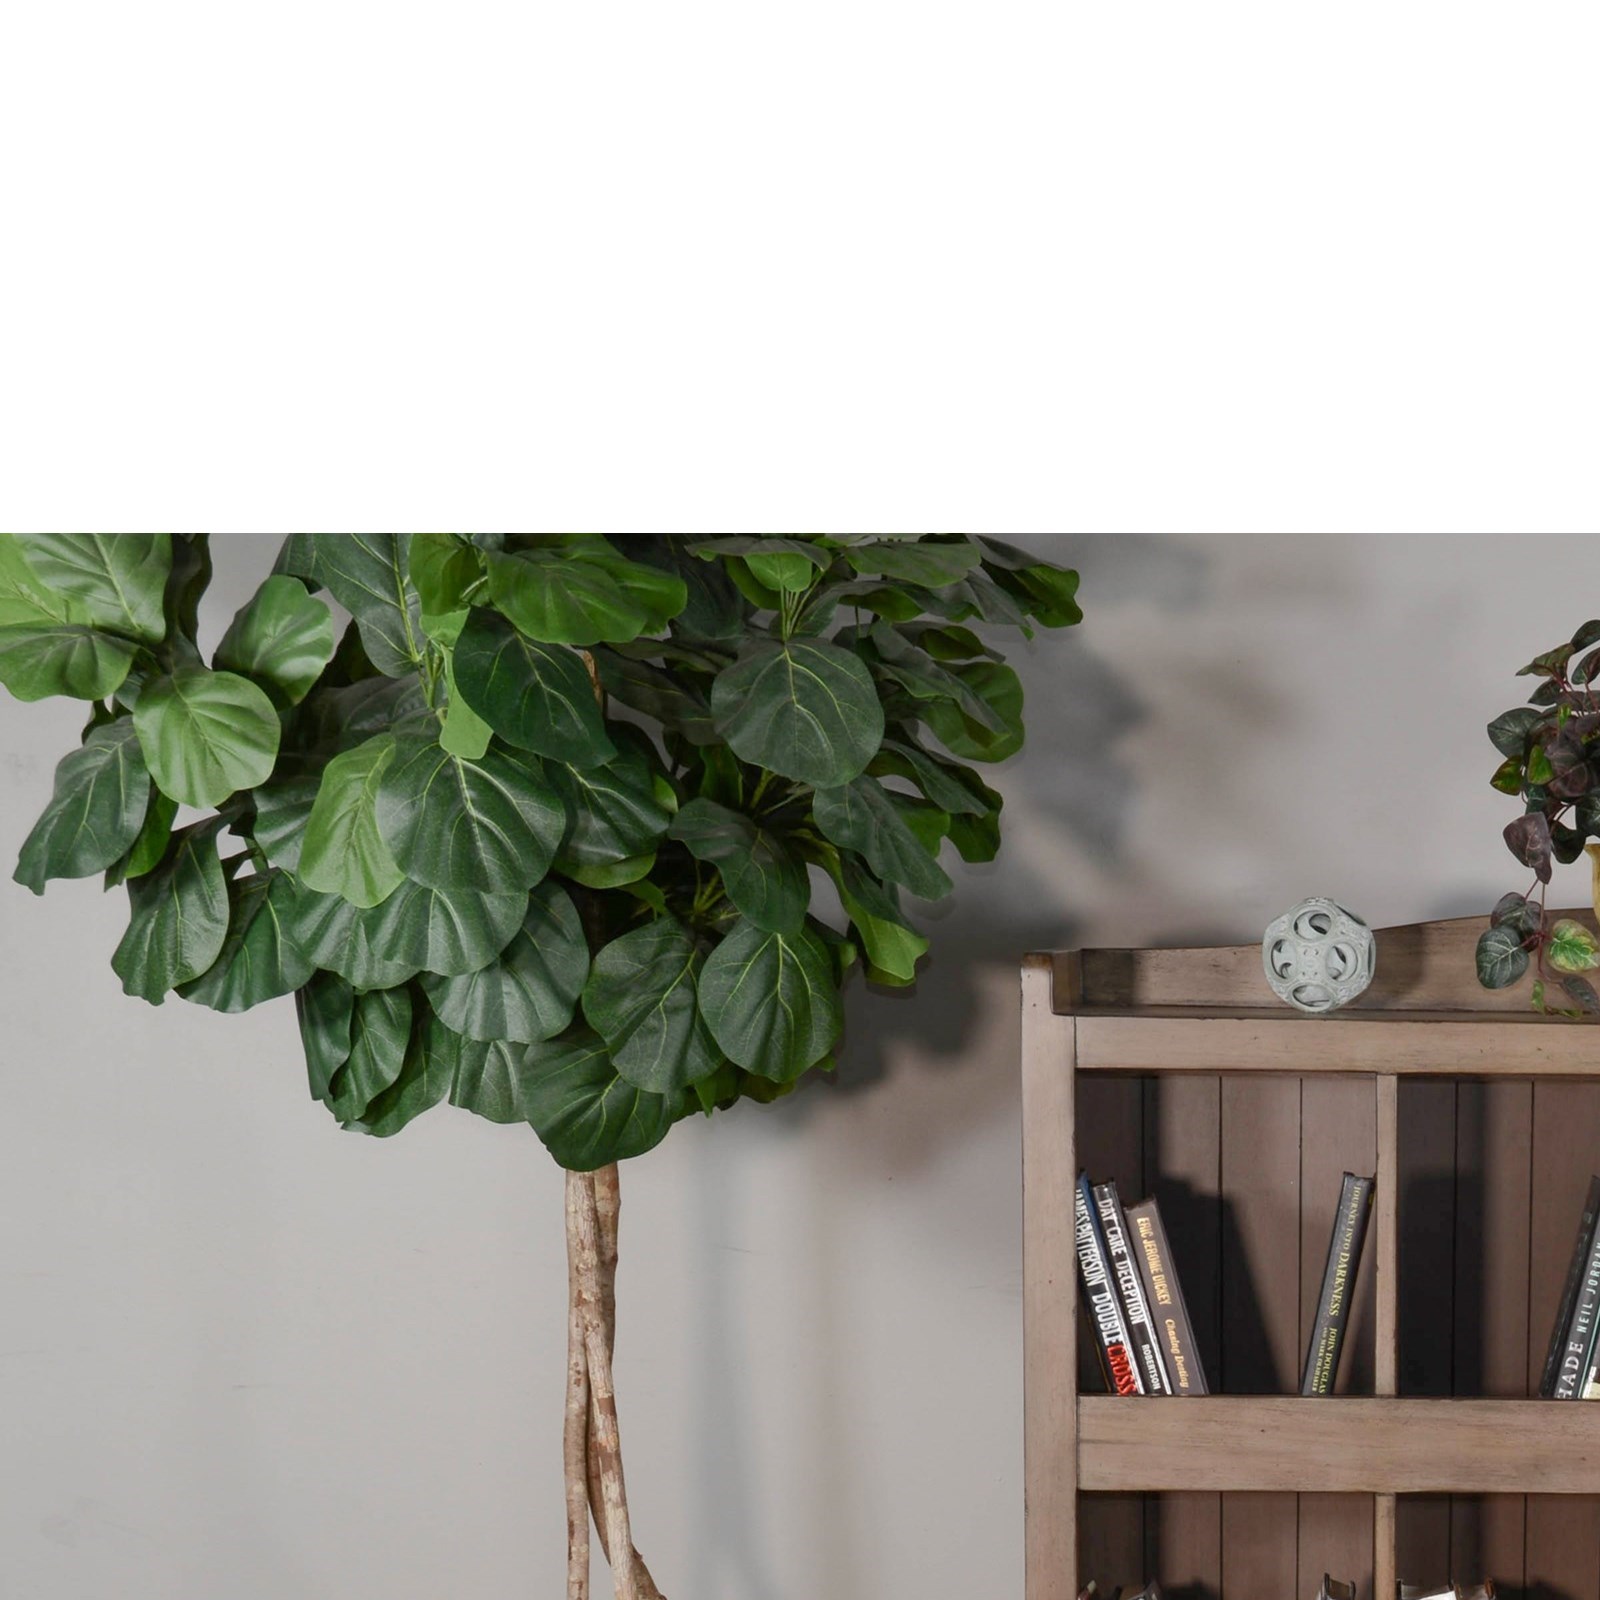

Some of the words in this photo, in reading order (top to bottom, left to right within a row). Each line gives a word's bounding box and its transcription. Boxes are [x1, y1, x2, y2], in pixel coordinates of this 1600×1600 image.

[1098, 1198, 1118, 1224] DAY
[1347, 1186, 1361, 1225] JOURNEY
[1106, 1225, 1126, 1256] CARE
[1137, 1217, 1153, 1238] ERIC
[1343, 1228, 1353, 1250] INTO
[1076, 1223, 1107, 1286] PATTERSON
[1143, 1239, 1162, 1274] JEROME
[1116, 1258, 1146, 1324] DECEPTION
[1152, 1274, 1171, 1305] DICKEY
[1329, 1252, 1350, 1315] DARKNESS
[1092, 1291, 1123, 1346] DOUBLE
[1576, 1304, 1593, 1333] NEIL
[1165, 1319, 1180, 1354] Chasing
[1174, 1355, 1189, 1388] Destiny
[1327, 1327, 1337, 1350] JOHN
[1107, 1343, 1137, 1395] CROSS
[1142, 1344, 1161, 1390] ROBERTSON
[1319, 1353, 1332, 1393] DOUGLAS
